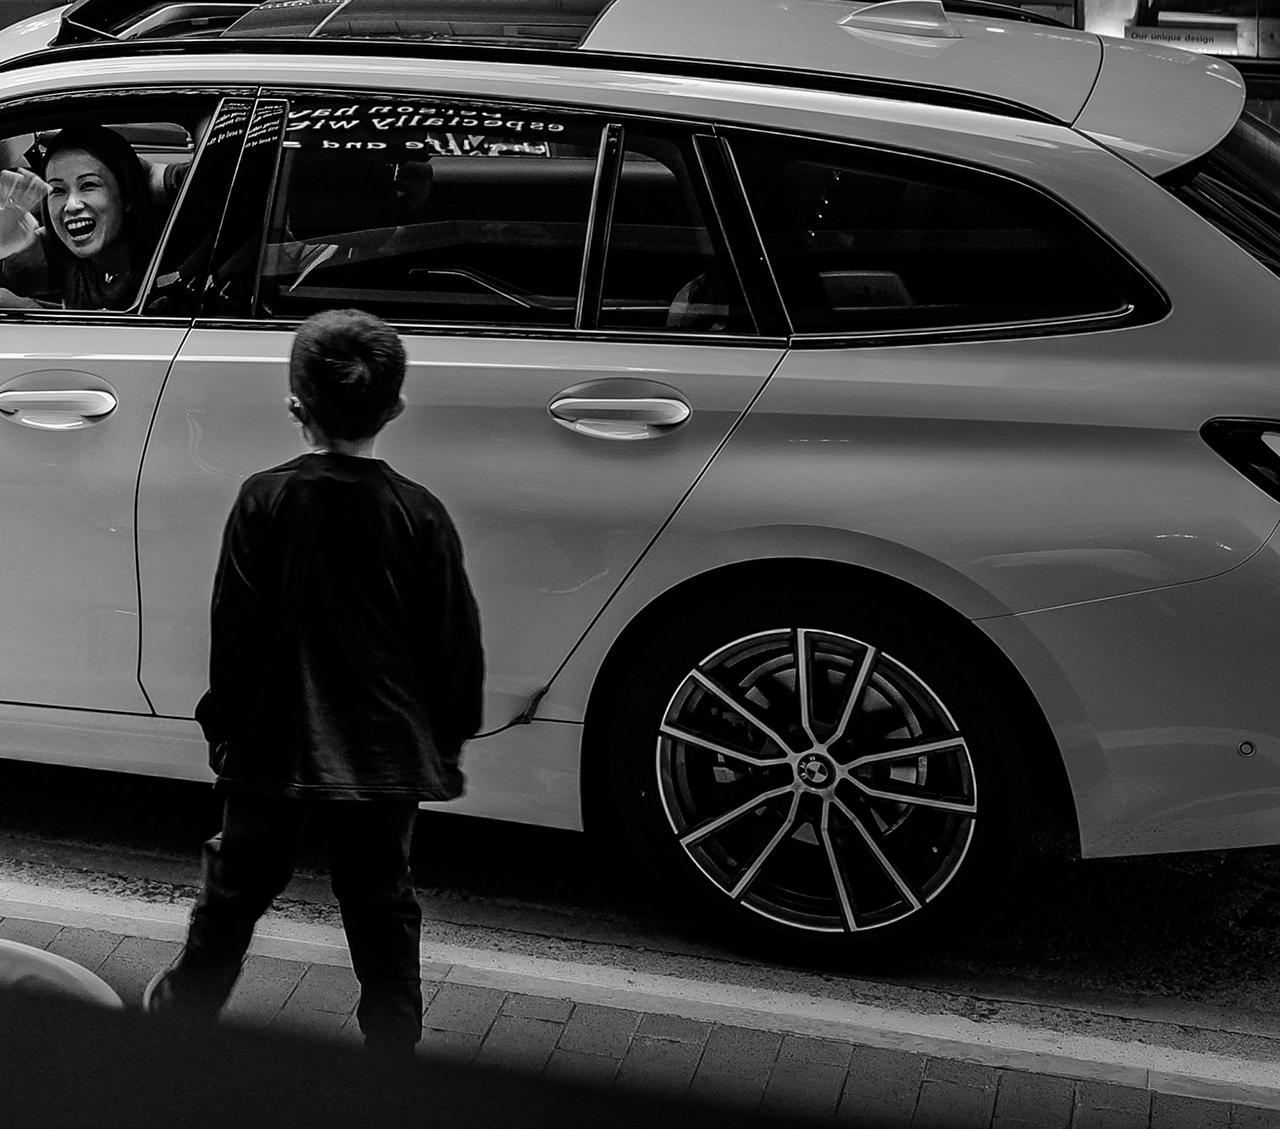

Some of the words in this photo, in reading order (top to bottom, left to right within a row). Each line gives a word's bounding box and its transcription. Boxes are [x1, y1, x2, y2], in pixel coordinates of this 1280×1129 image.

[1130, 31, 1148, 40] Our
[1151, 32, 1182, 42] unique
[1184, 33, 1215, 44] design
